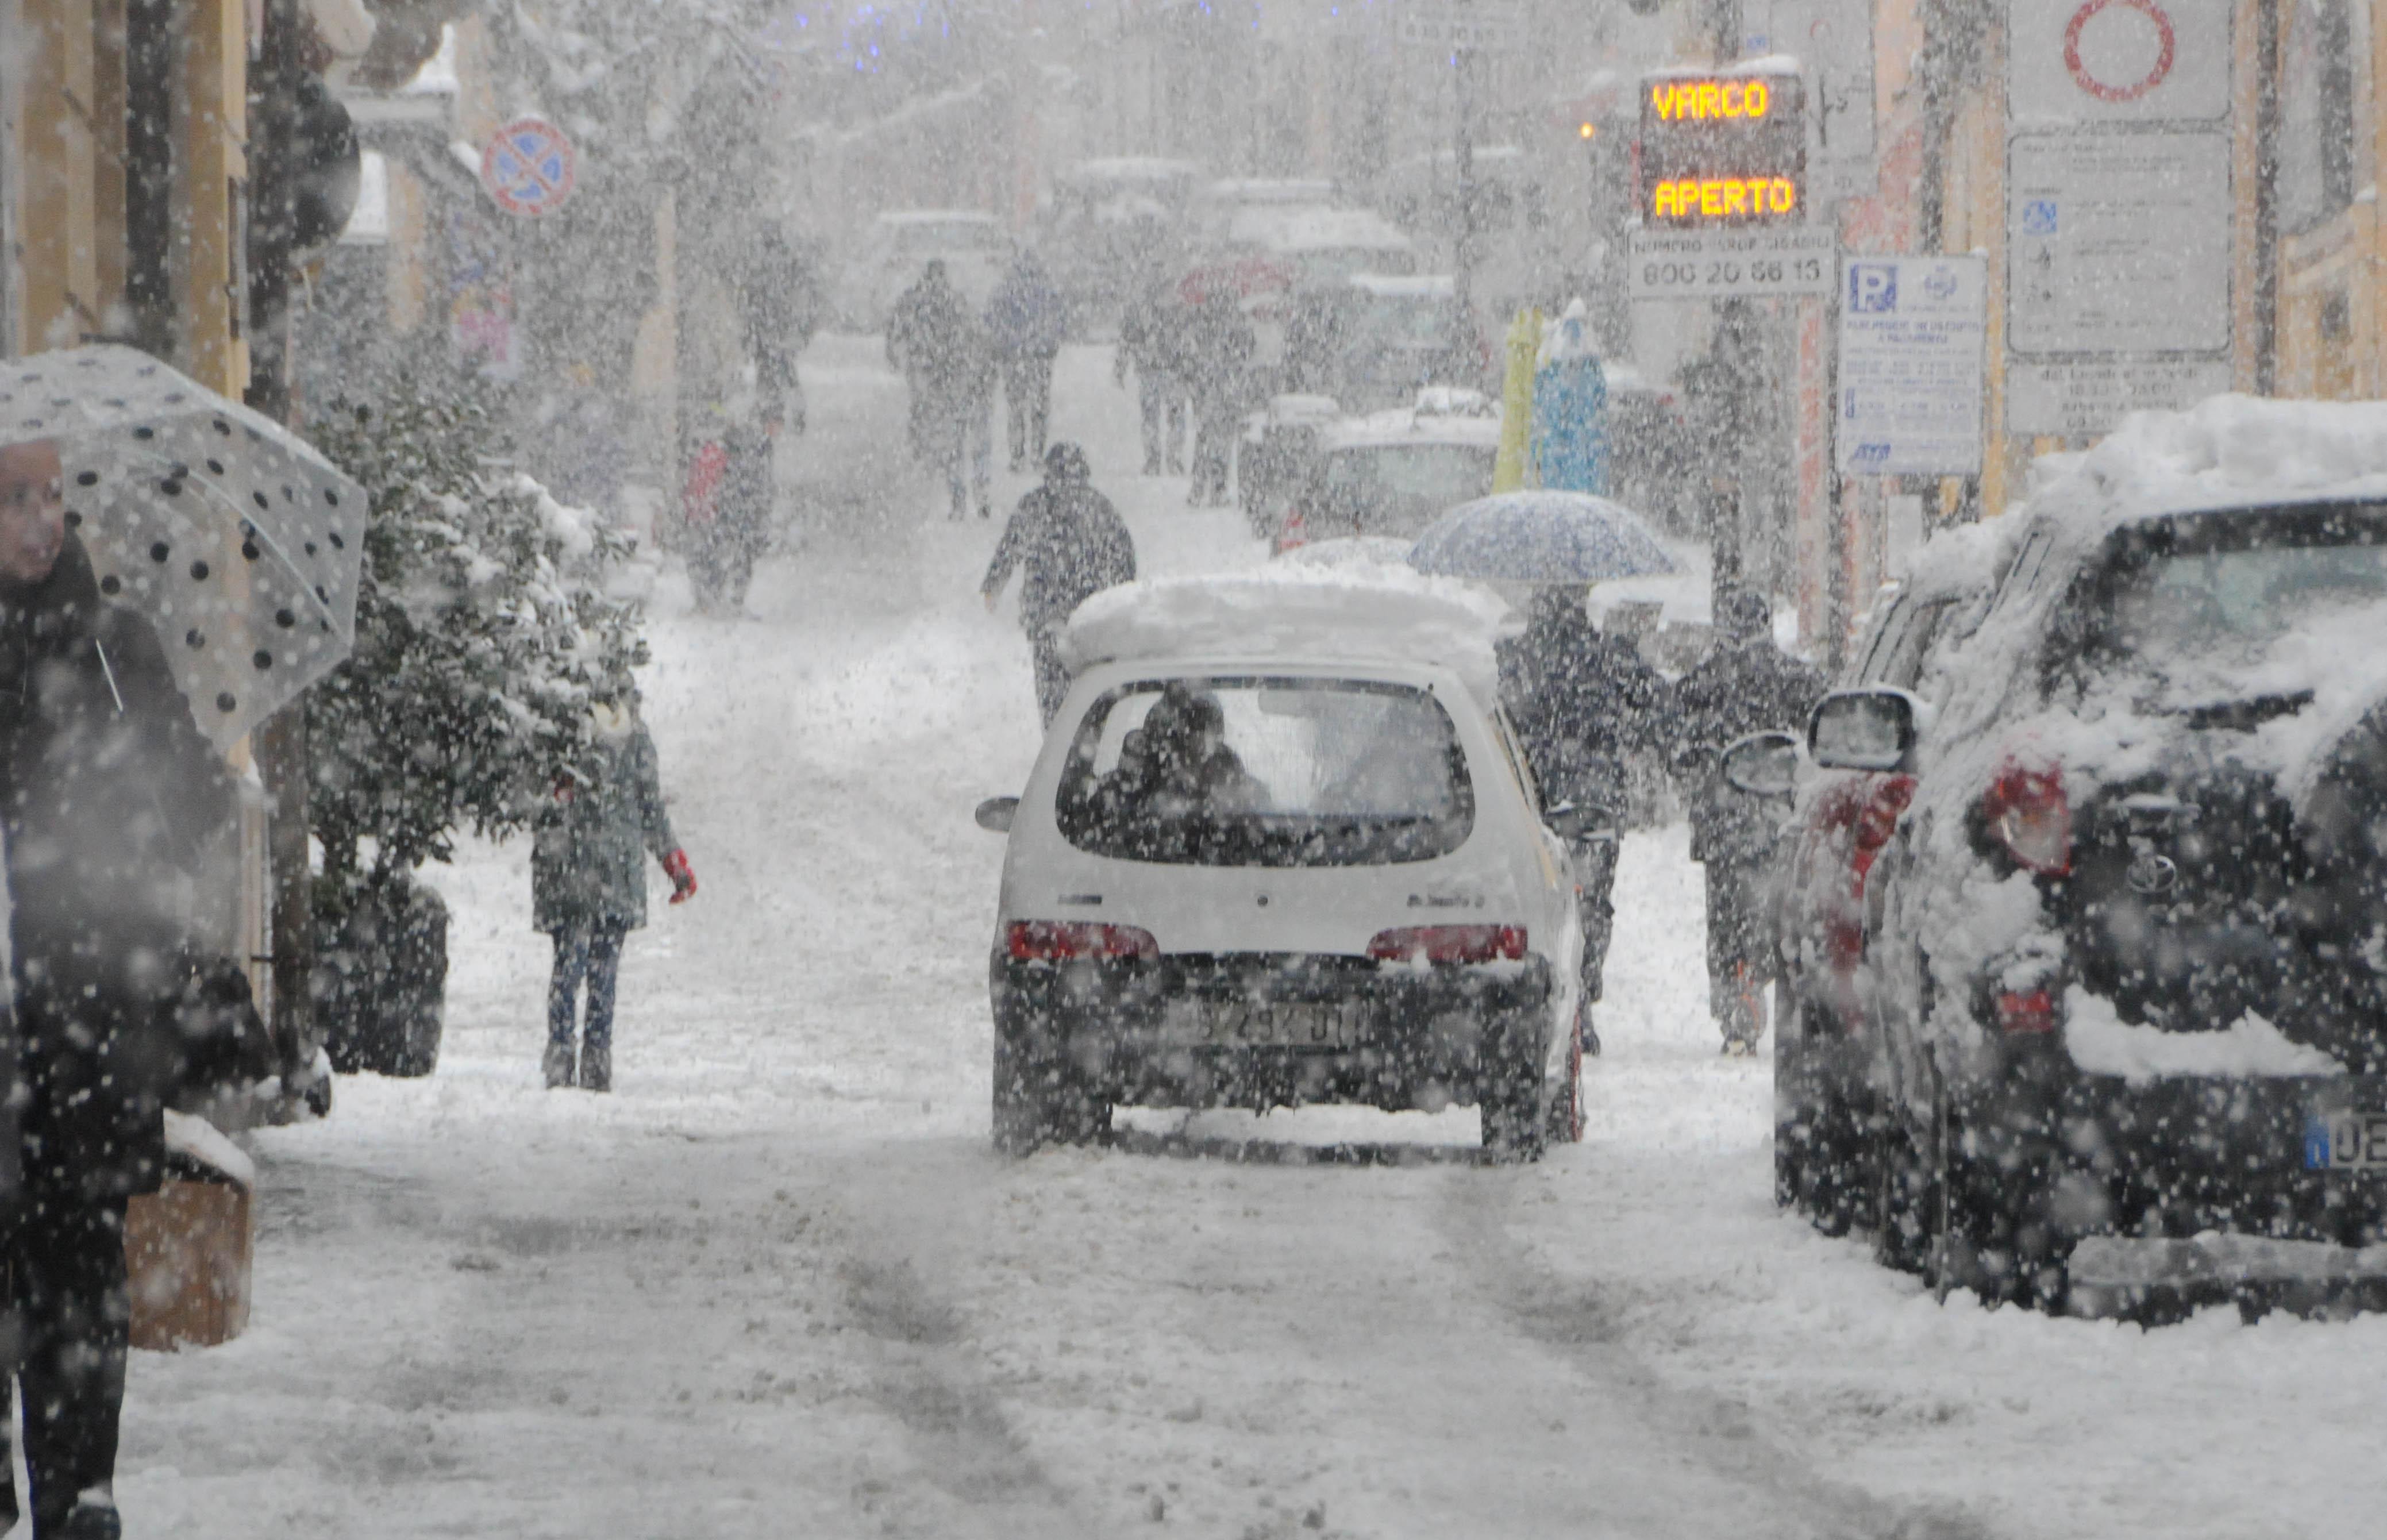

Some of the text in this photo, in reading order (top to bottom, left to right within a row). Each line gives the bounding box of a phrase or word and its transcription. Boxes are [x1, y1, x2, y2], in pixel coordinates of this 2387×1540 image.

[1653, 80, 1769, 120] VARCO
[1656, 177, 1794, 217] APERTO
[1643, 263, 1696, 286] 800
[1706, 261, 1741, 283] 20
